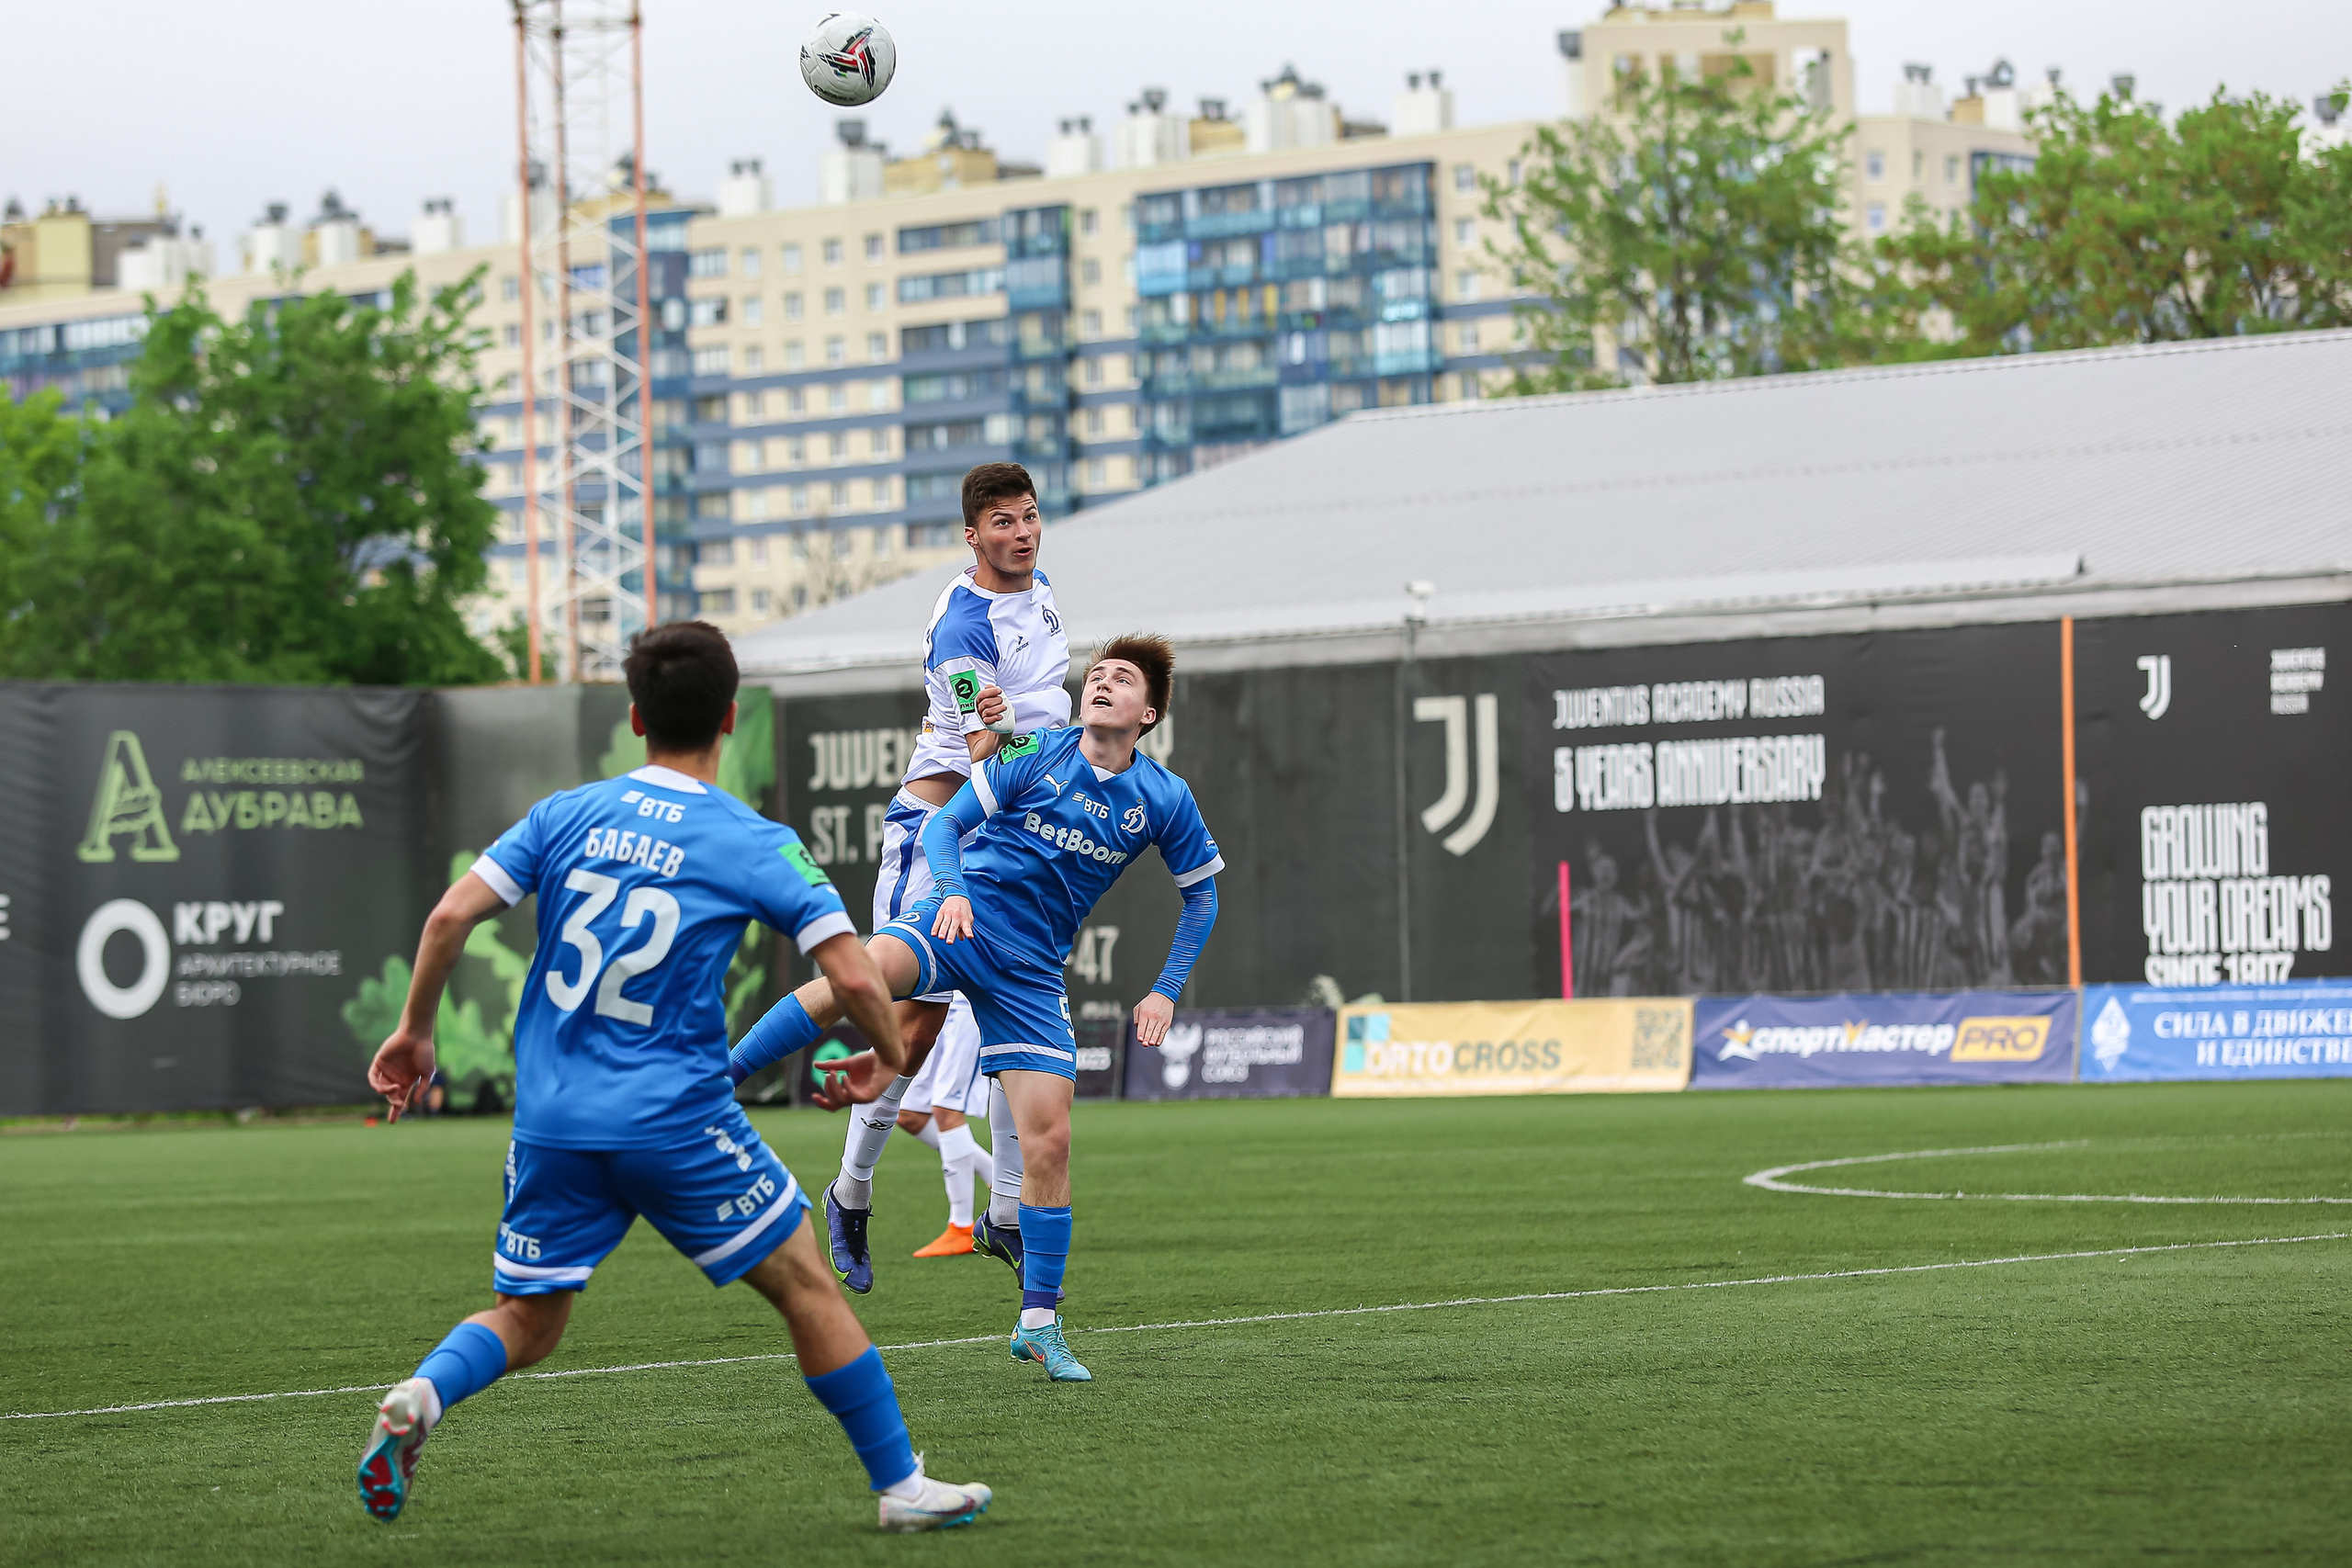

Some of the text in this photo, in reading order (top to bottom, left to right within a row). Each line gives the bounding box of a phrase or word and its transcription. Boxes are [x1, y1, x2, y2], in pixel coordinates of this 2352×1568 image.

[958, 683, 970, 694] 2
[1553, 674, 1825, 729] JUVENTUS ACADEMY RUSSIA
[179, 758, 365, 784] АЛЕКСЕЕВСКАЯ
[808, 728, 917, 792] JUVE
[1554, 734, 1826, 812] 5 YEARS ANNIVERSARY
[181, 791, 364, 834] ДУБРАВА
[638, 796, 685, 824] ВТБ
[1082, 799, 1110, 820] ВТБ
[585, 827, 685, 878] БАБАЕВ
[810, 804, 860, 865] ST.
[1023, 812, 1128, 864] BetBoom
[2141, 801, 2269, 881] GROWING
[174, 899, 284, 944] КРУГ
[2143, 874, 2333, 955] YOUR DREAMS
[545, 868, 681, 1027] 32
[1960, 1025, 2041, 1053] PRO
[2154, 1011, 2228, 1039] СИЛА
[2233, 1010, 2251, 1037] В
[1365, 1038, 1562, 1075] ORTOCROSS
[2196, 1039, 2218, 1067] И
[735, 1172, 775, 1217] ВТБ
[506, 1230, 541, 1259] ВТБ
